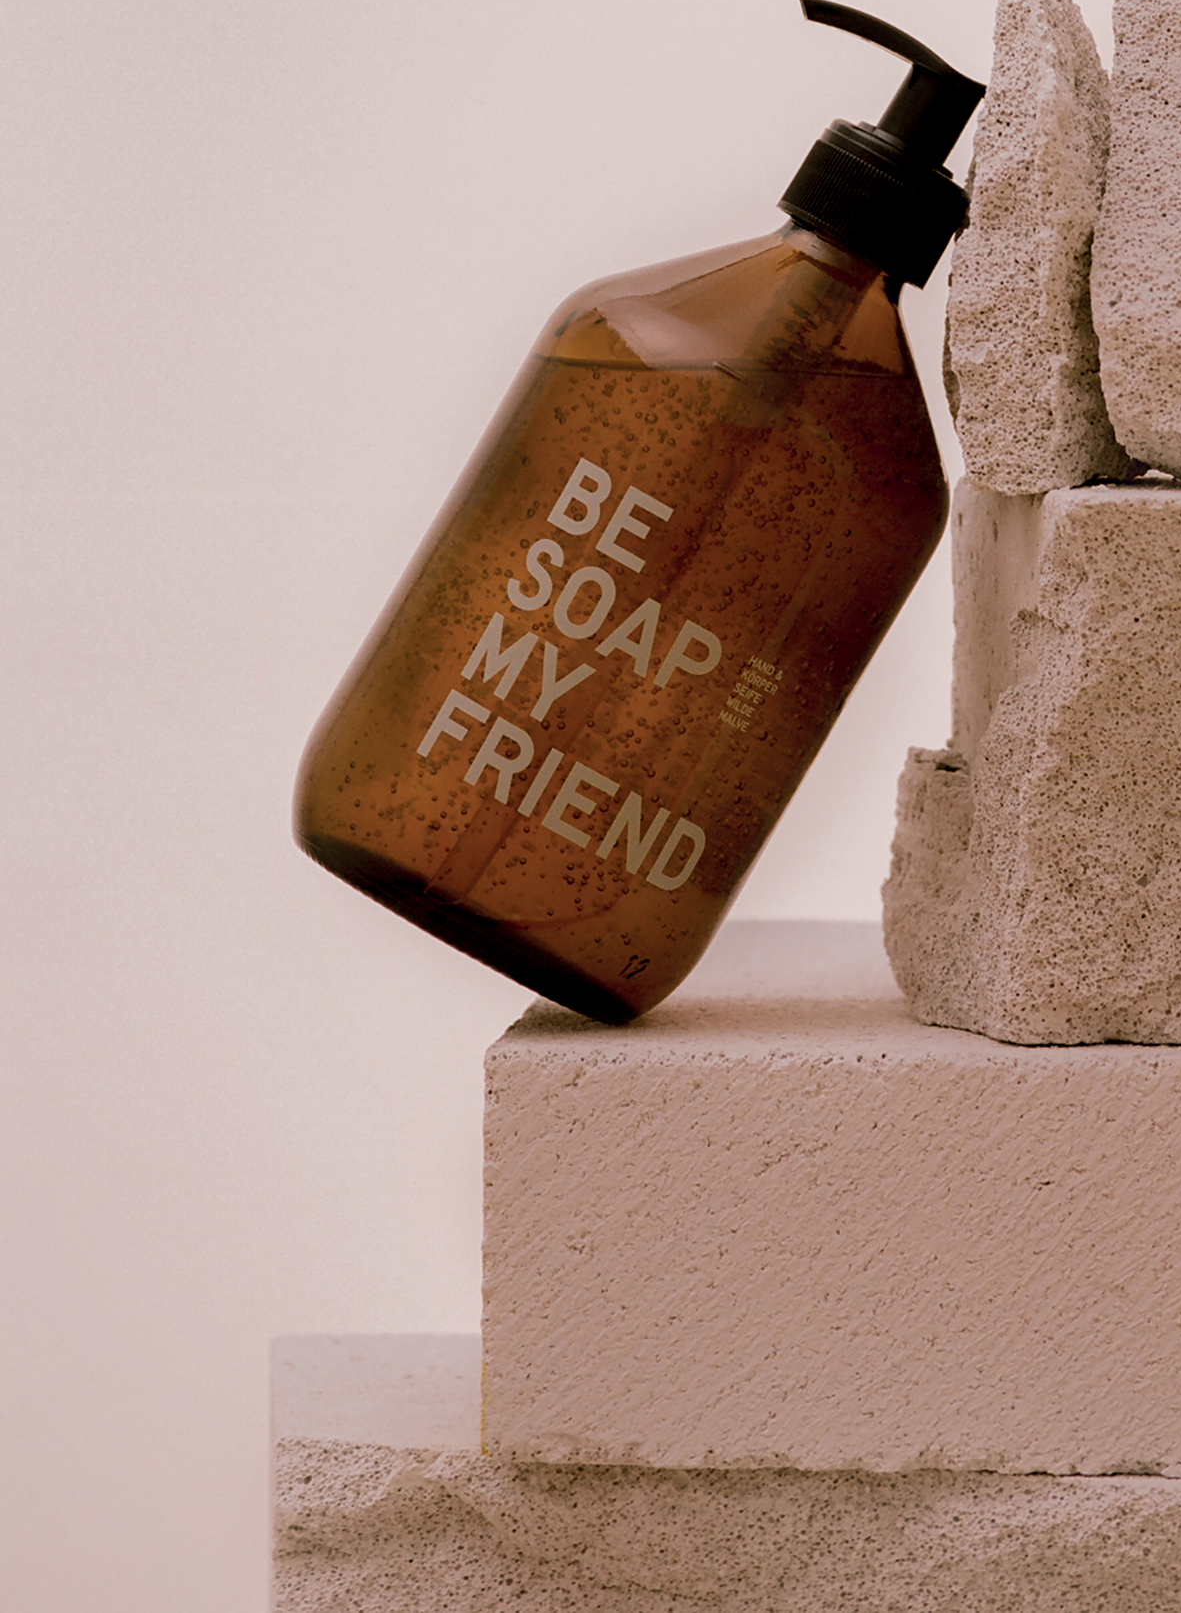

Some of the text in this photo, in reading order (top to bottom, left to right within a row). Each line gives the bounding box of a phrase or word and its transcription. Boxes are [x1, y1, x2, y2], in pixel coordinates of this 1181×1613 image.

[546, 457, 674, 574] BE
[506, 538, 722, 688] SOAP
[460, 611, 596, 722] MY
[748, 655, 783, 681] HAND &
[733, 682, 762, 704] SEIFE
[741, 669, 778, 695] KÖRPER
[726, 696, 755, 718] WILDE
[718, 709, 750, 733] MALVE
[416, 688, 706, 891] FRIEND
